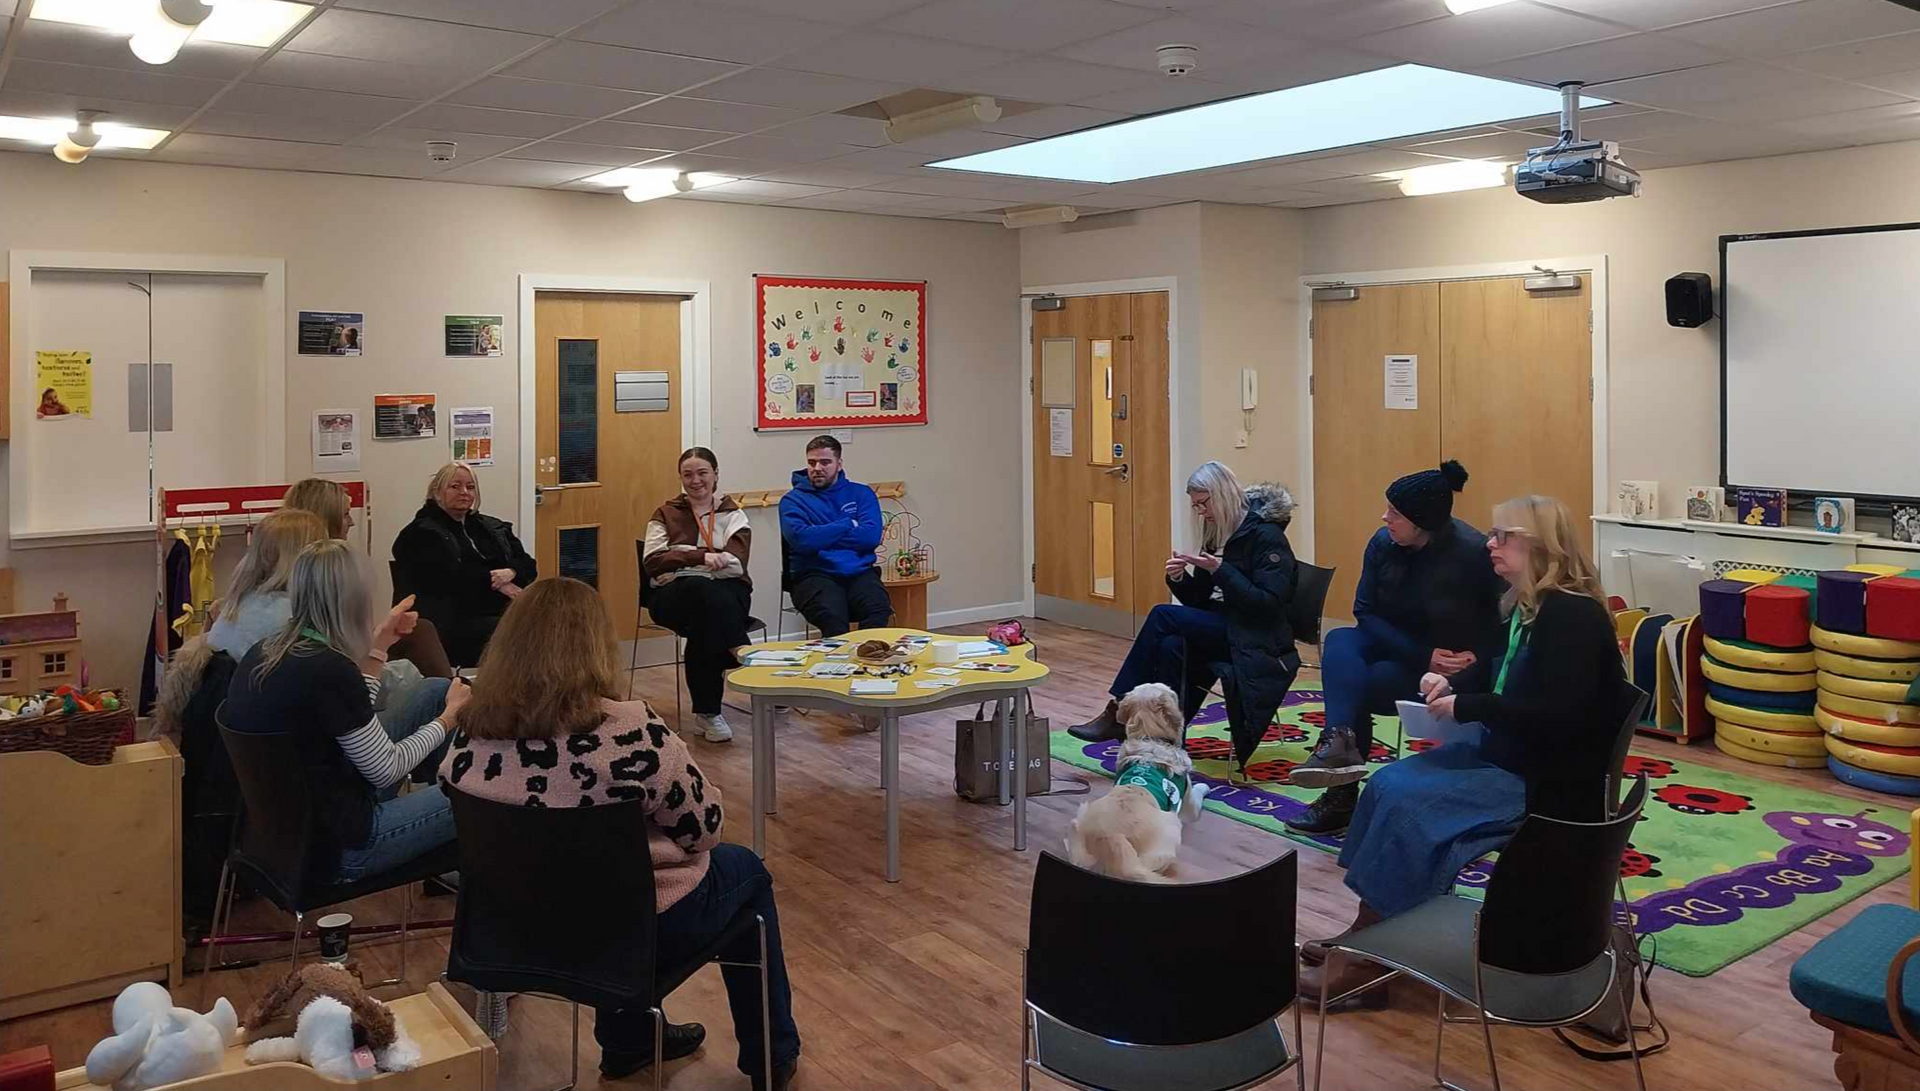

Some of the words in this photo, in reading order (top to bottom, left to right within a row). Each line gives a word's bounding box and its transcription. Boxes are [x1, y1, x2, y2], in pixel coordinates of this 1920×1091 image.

[771, 300, 912, 330] Welcome
[983, 757, 1015, 771] TOE
[1247, 797, 1283, 812] Kk
[1801, 848, 1852, 868] Aa
[1765, 869, 1822, 887] Bb
[1721, 884, 1770, 898] Cc
[1660, 898, 1729, 921] Dd
